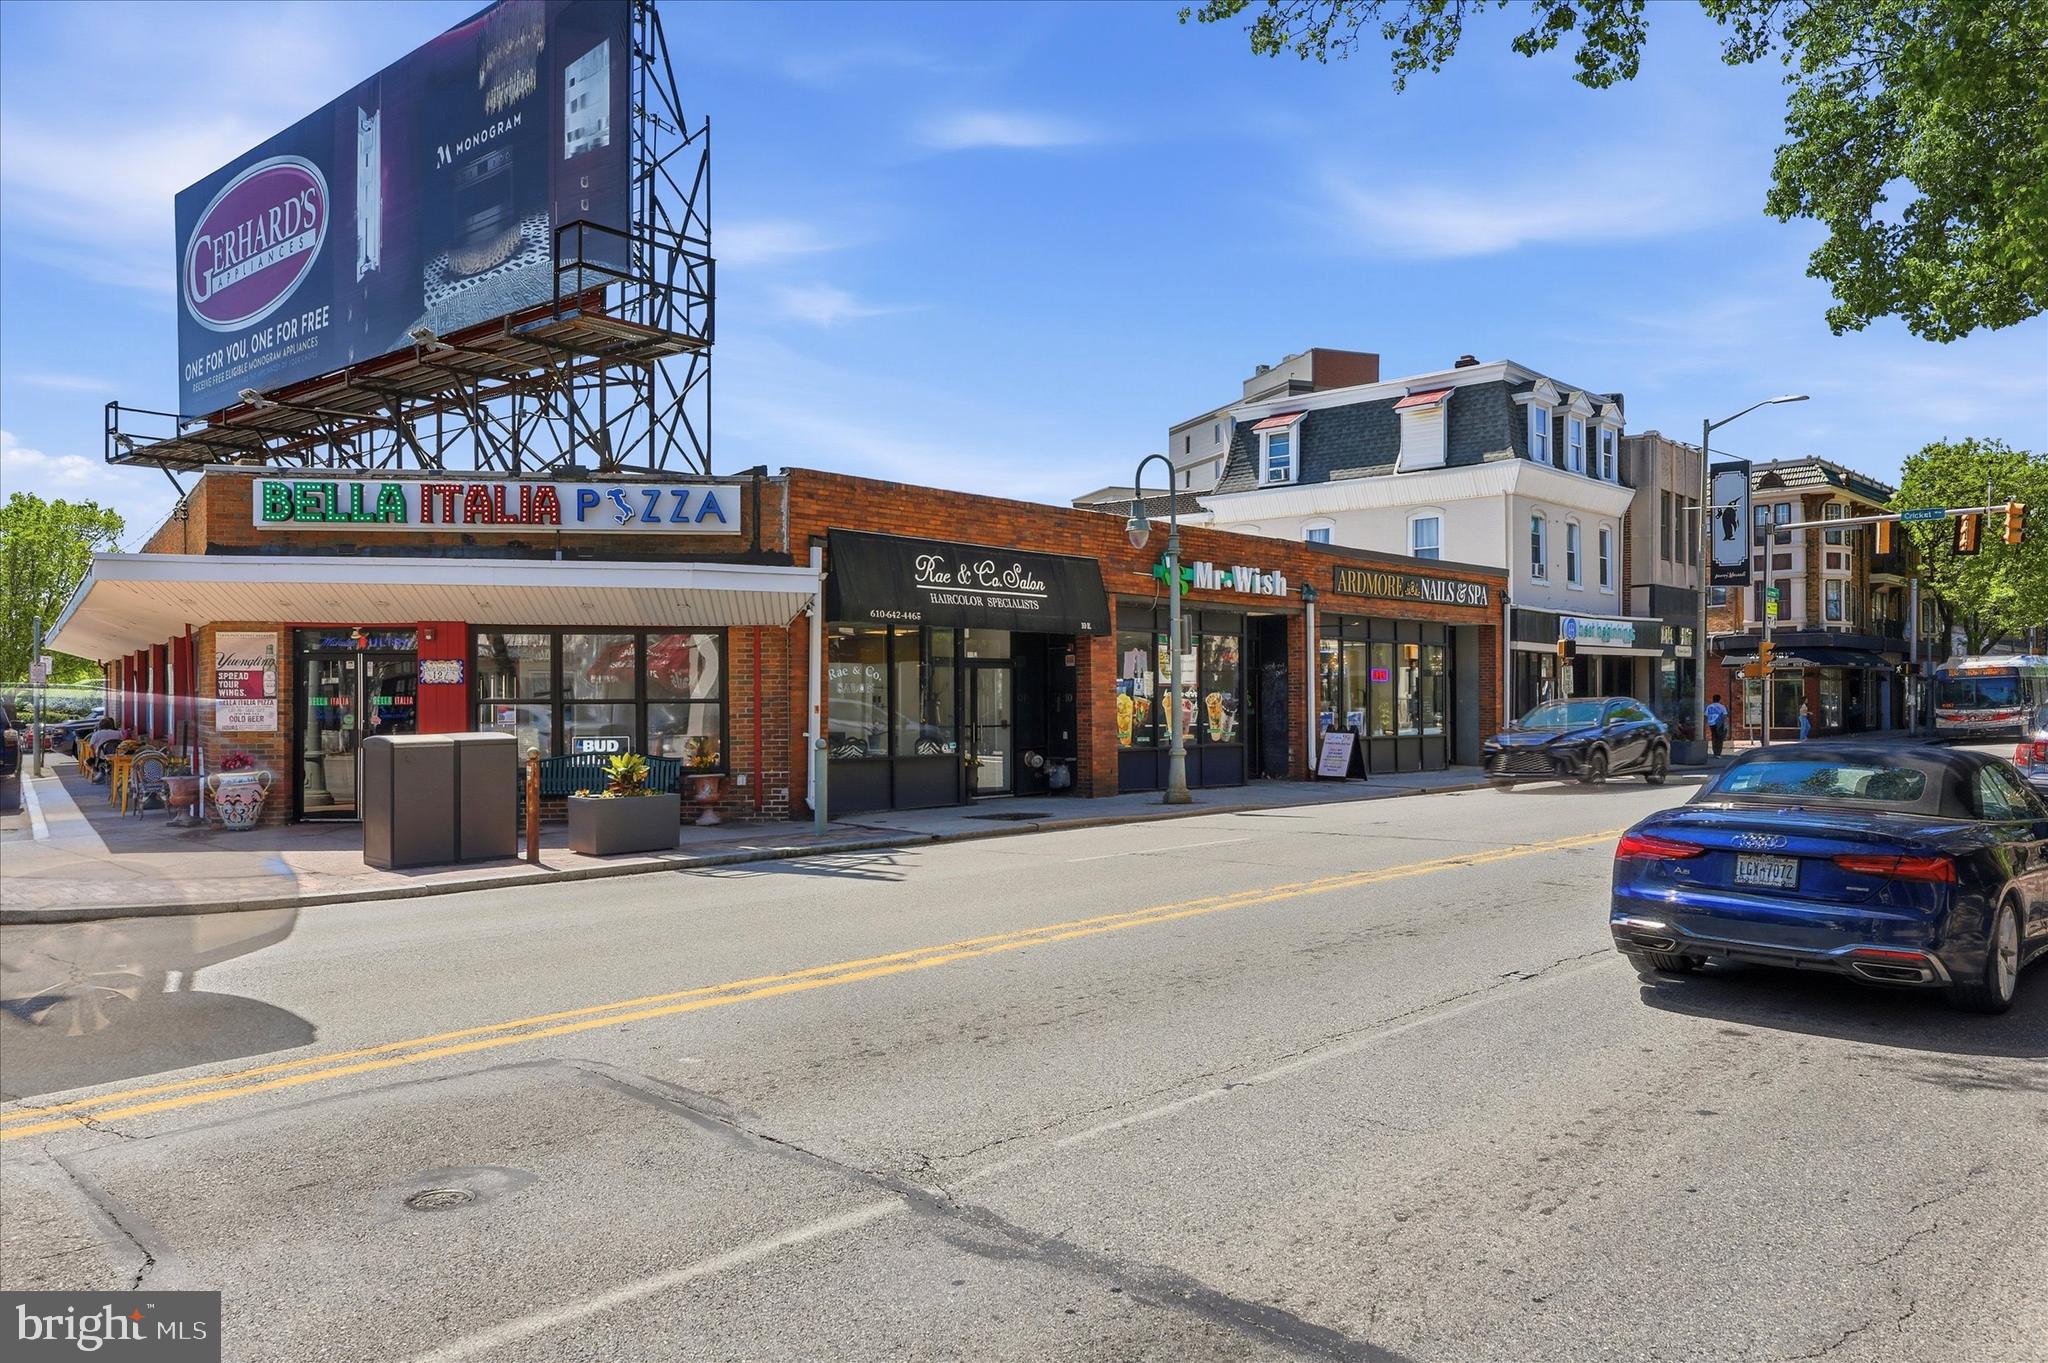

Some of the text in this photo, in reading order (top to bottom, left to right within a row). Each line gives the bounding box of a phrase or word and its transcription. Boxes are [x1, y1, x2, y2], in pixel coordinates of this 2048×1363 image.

[455, 111, 522, 156] MONOGRAM
[190, 187, 316, 303] GERHARD'S
[218, 236, 304, 288] APPLIANCES
[185, 356, 203, 382] ONE
[206, 346, 223, 374] FOR
[251, 328, 273, 354] ONE
[276, 318, 298, 345] FOR
[301, 305, 330, 336] FREE
[192, 377, 212, 393] RECEIVE
[212, 372, 225, 386] FREE
[225, 363, 248, 381] ELIGIBLE
[248, 351, 282, 373] MONOGRAM
[282, 335, 319, 358] APPLIANCES
[262, 481, 408, 523] BELLA
[420, 483, 562, 525] ITALIA
[1904, 511, 1932, 520] Cricket
[914, 554, 1046, 591] Rae & Co. Salon
[1337, 569, 1489, 606] ARDMORE NAILS & SPA
[930, 592, 1040, 610] HAIRCOLOR SPECIALISTS
[215, 651, 276, 669] Yuengling
[218, 672, 249, 680] SPREAD
[828, 666, 848, 680] Rae
[218, 680, 239, 689] YOUR
[330, 697, 349, 706] ITALIA
[394, 696, 414, 705] ITALIA
[229, 715, 265, 723] COLD BEER
[582, 739, 620, 753] BUD
